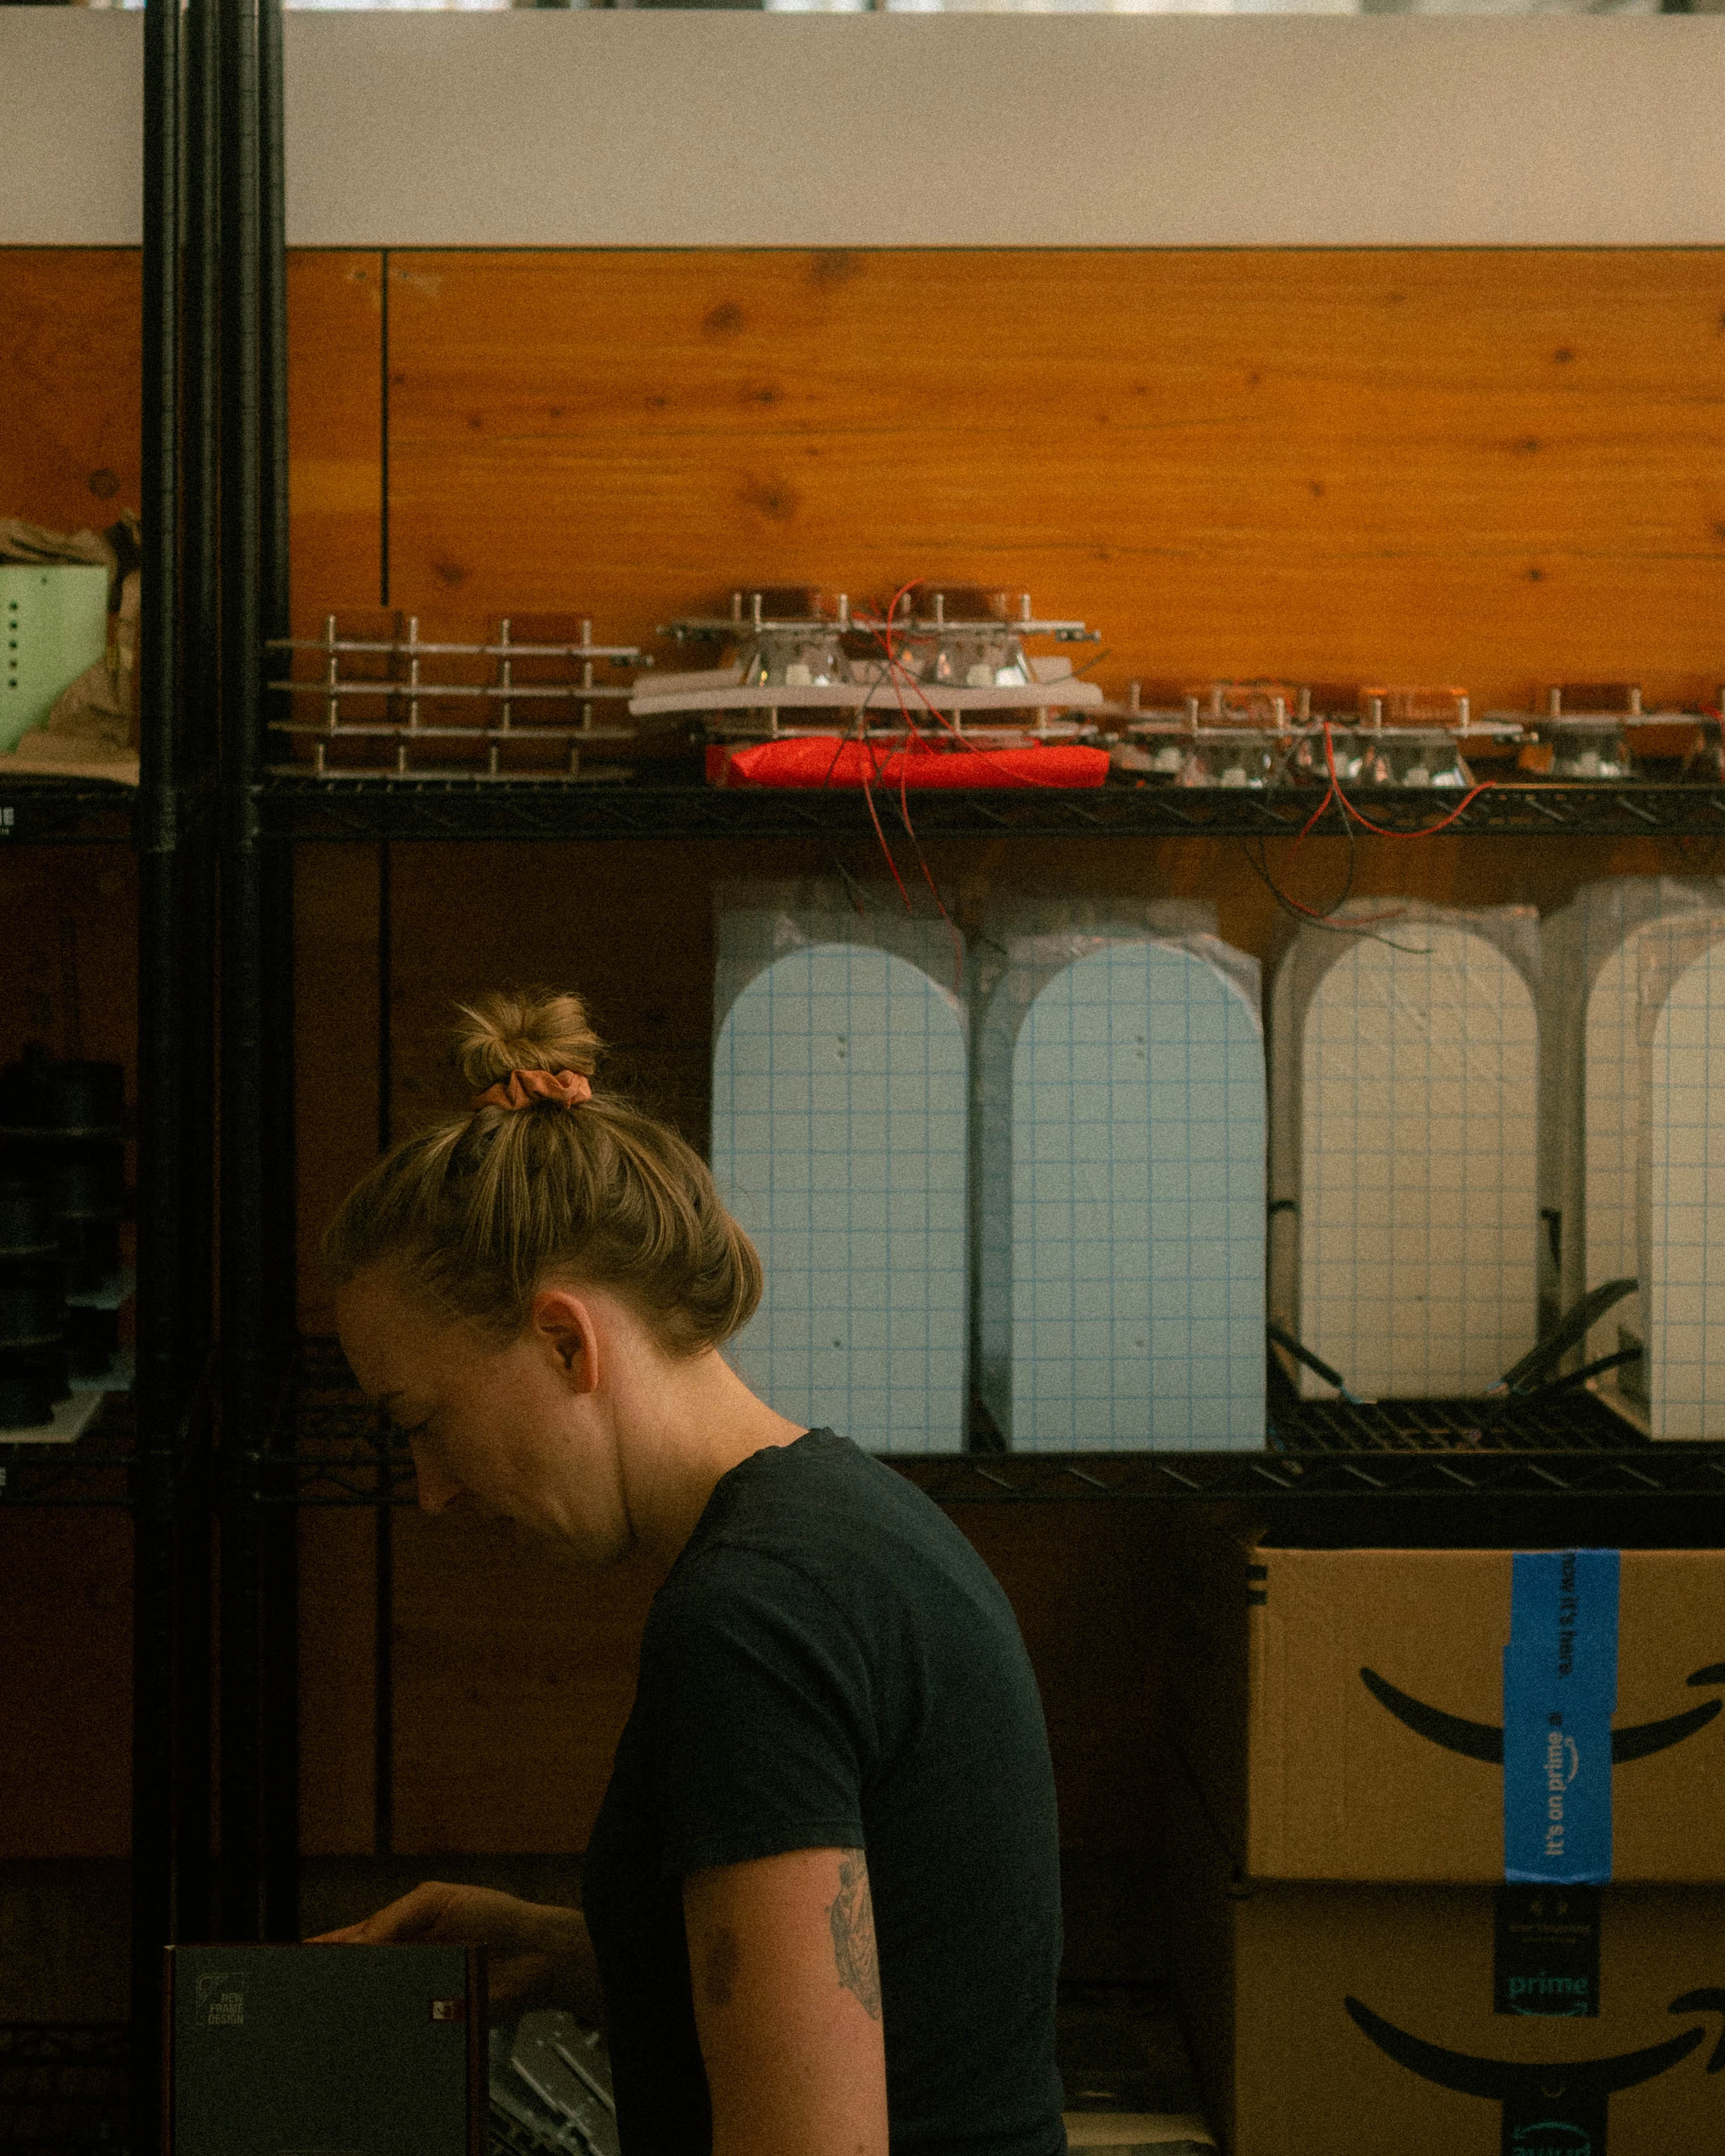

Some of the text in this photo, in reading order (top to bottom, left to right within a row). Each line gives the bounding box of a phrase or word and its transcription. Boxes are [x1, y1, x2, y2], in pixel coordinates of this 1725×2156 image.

[1542, 1731, 1567, 1792] prime
[1547, 1795, 1564, 1821] on
[1544, 1825, 1565, 1856] It's
[221, 1993, 244, 2003] NEW
[1509, 1970, 1588, 2000] prime
[208, 2013, 244, 2025] DESIGN
[210, 2003, 244, 2013] FRAME
